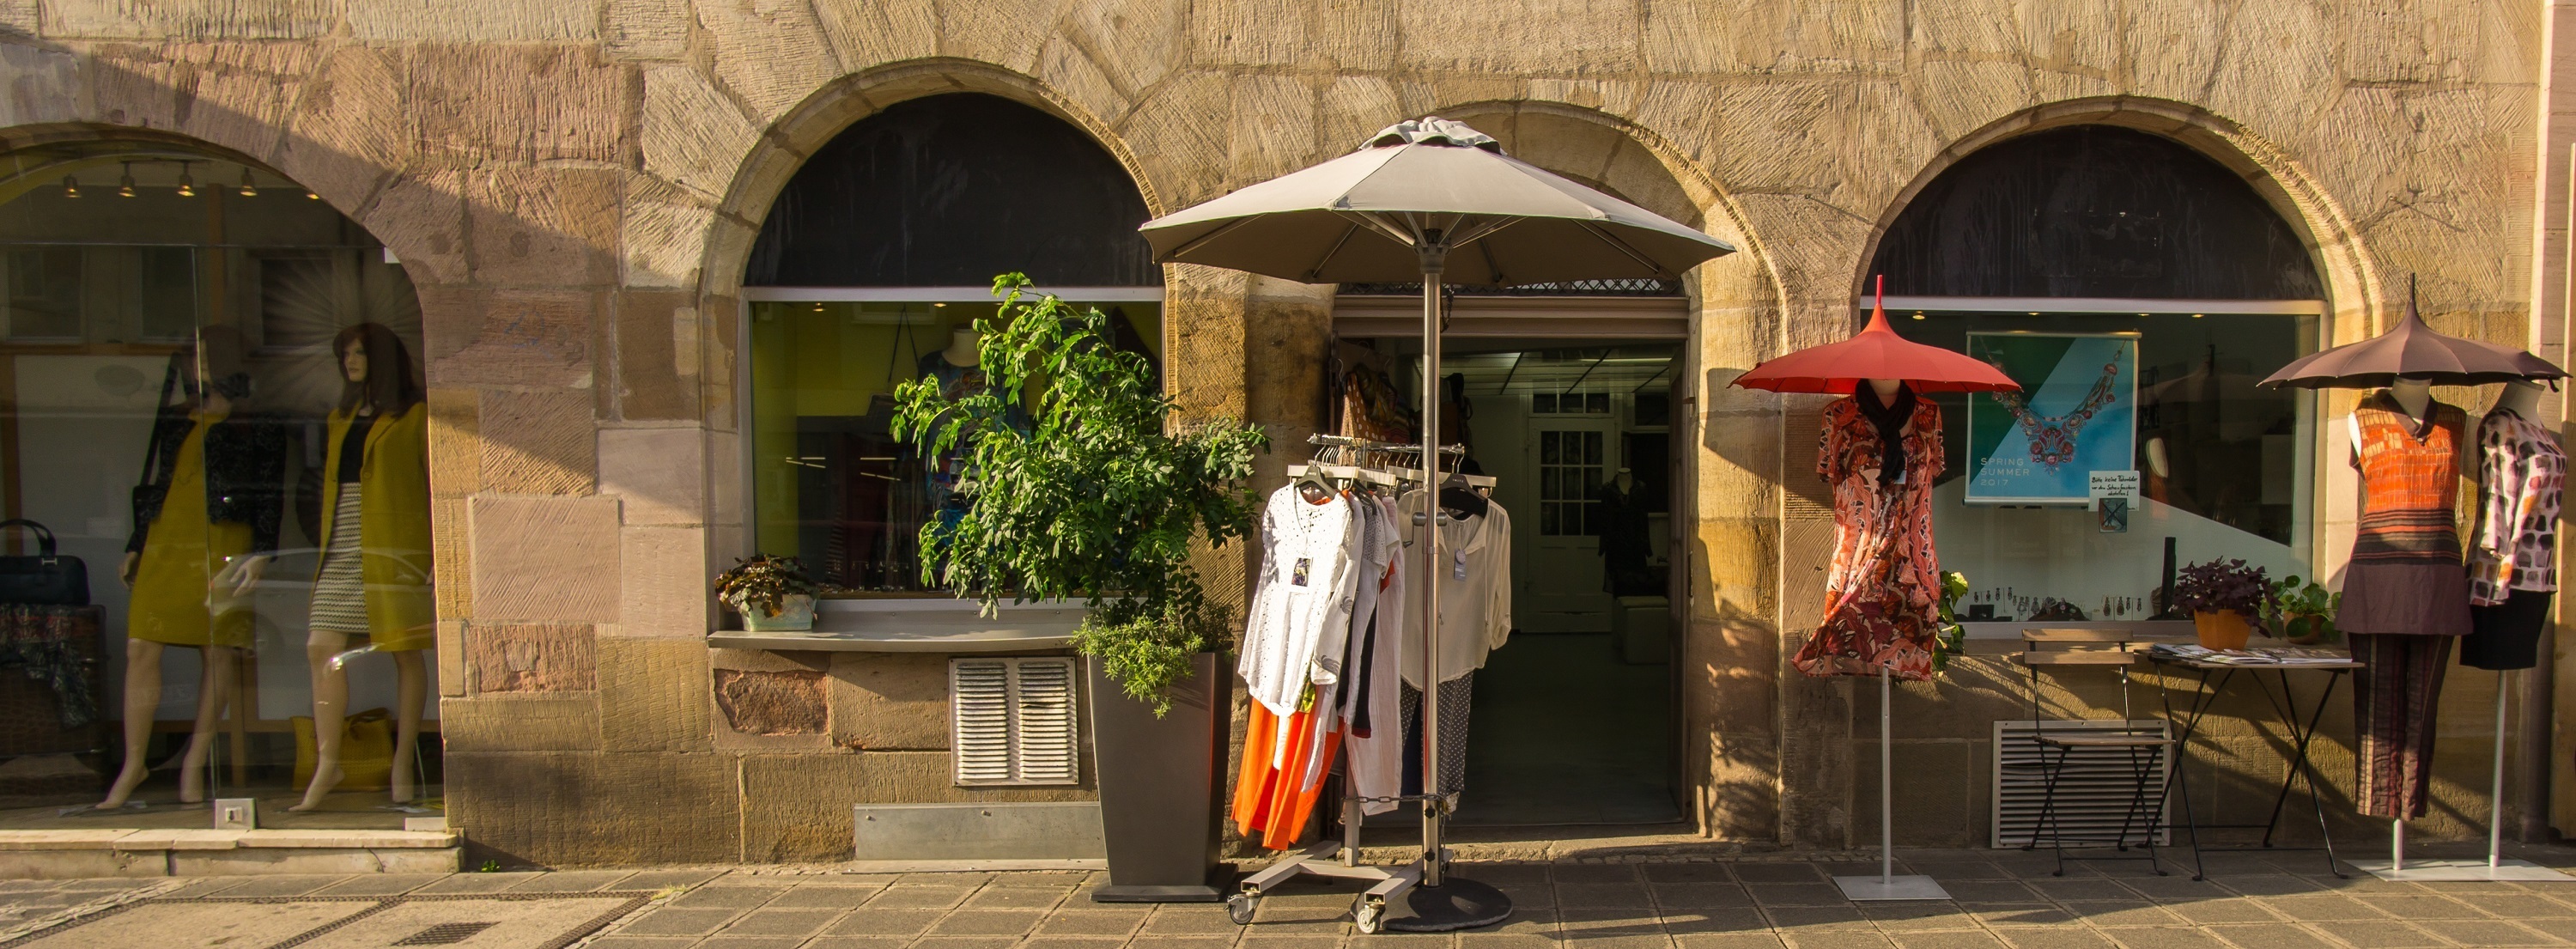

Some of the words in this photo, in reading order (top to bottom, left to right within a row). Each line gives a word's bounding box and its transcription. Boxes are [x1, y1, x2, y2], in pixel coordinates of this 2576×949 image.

[1980, 457, 2024, 466] SPRING
[1980, 468, 2030, 477] SUMMER
[1980, 478, 2008, 487] 2017
